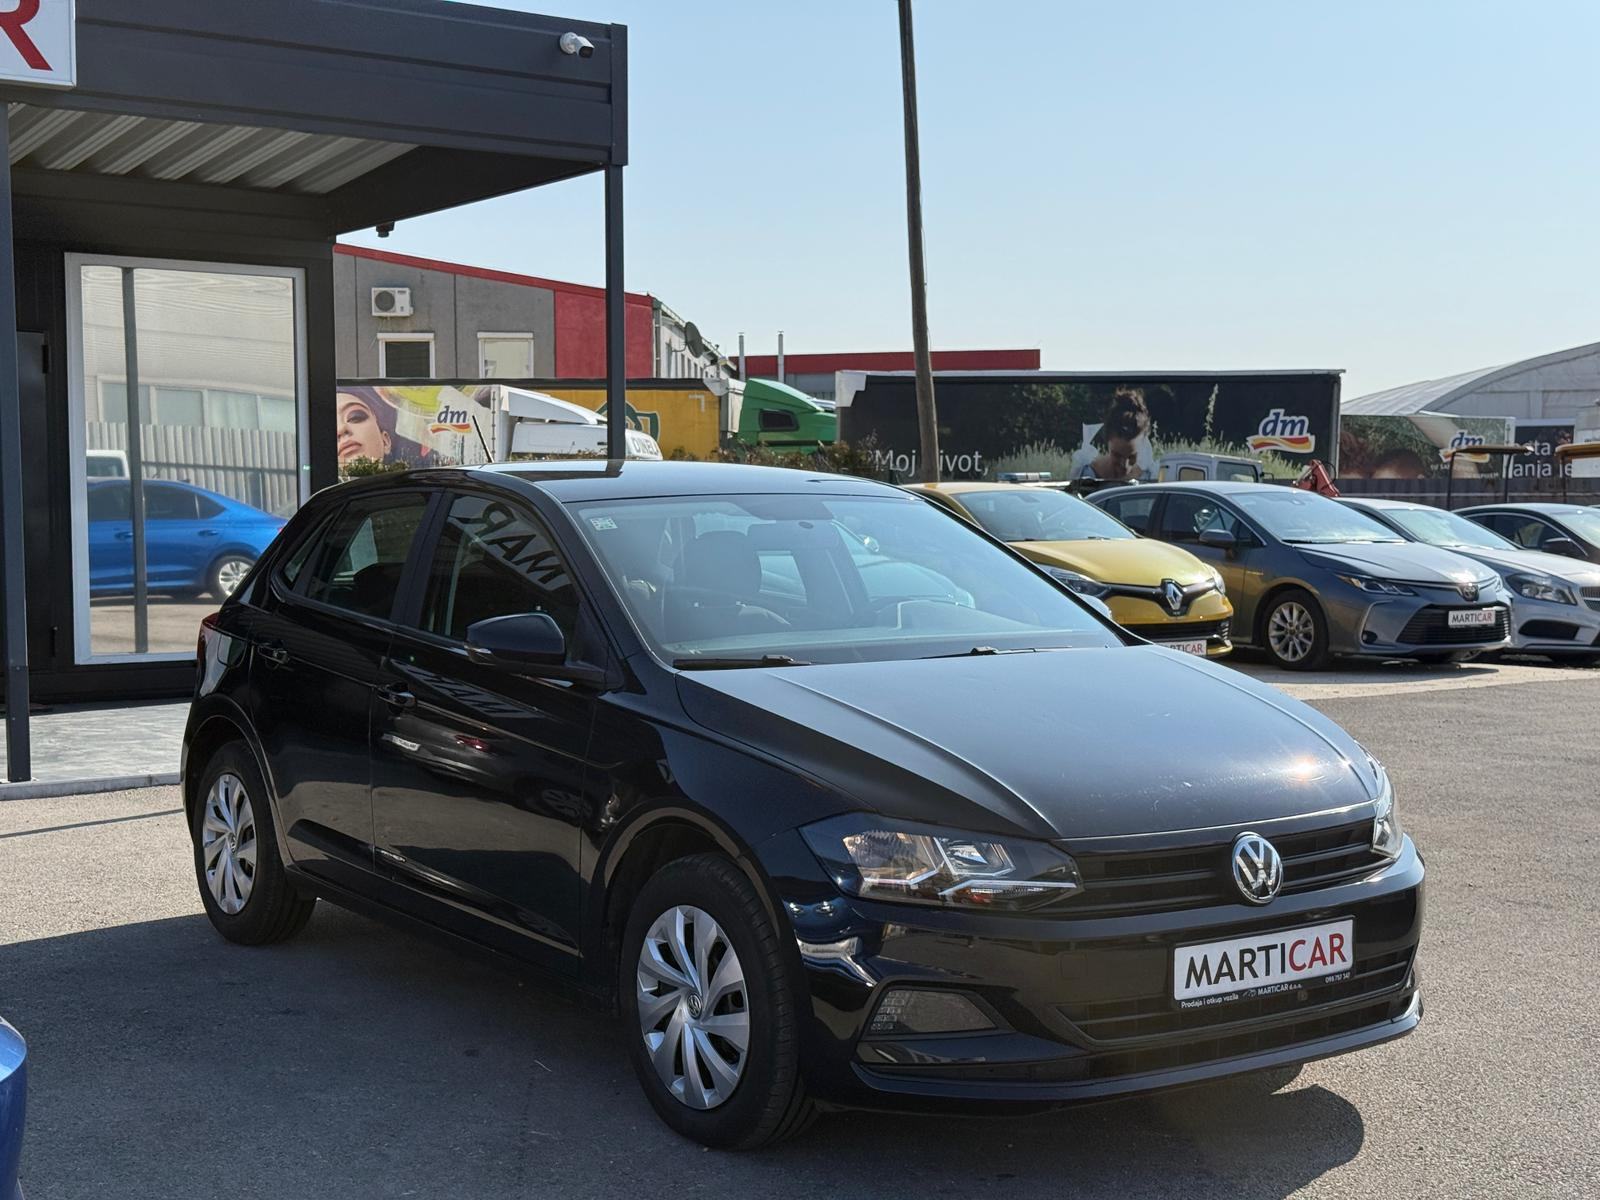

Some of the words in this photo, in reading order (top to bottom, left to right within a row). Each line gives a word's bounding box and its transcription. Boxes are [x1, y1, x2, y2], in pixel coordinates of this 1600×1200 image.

[437, 405, 467, 423] dm
[1262, 411, 1306, 436] dm
[875, 449, 916, 477] Moj
[938, 450, 989, 476] ivot,
[1451, 612, 1493, 623] MARTICAR
[1184, 932, 1348, 989] MARTICAR
[1257, 983, 1289, 996] MARTICAR
